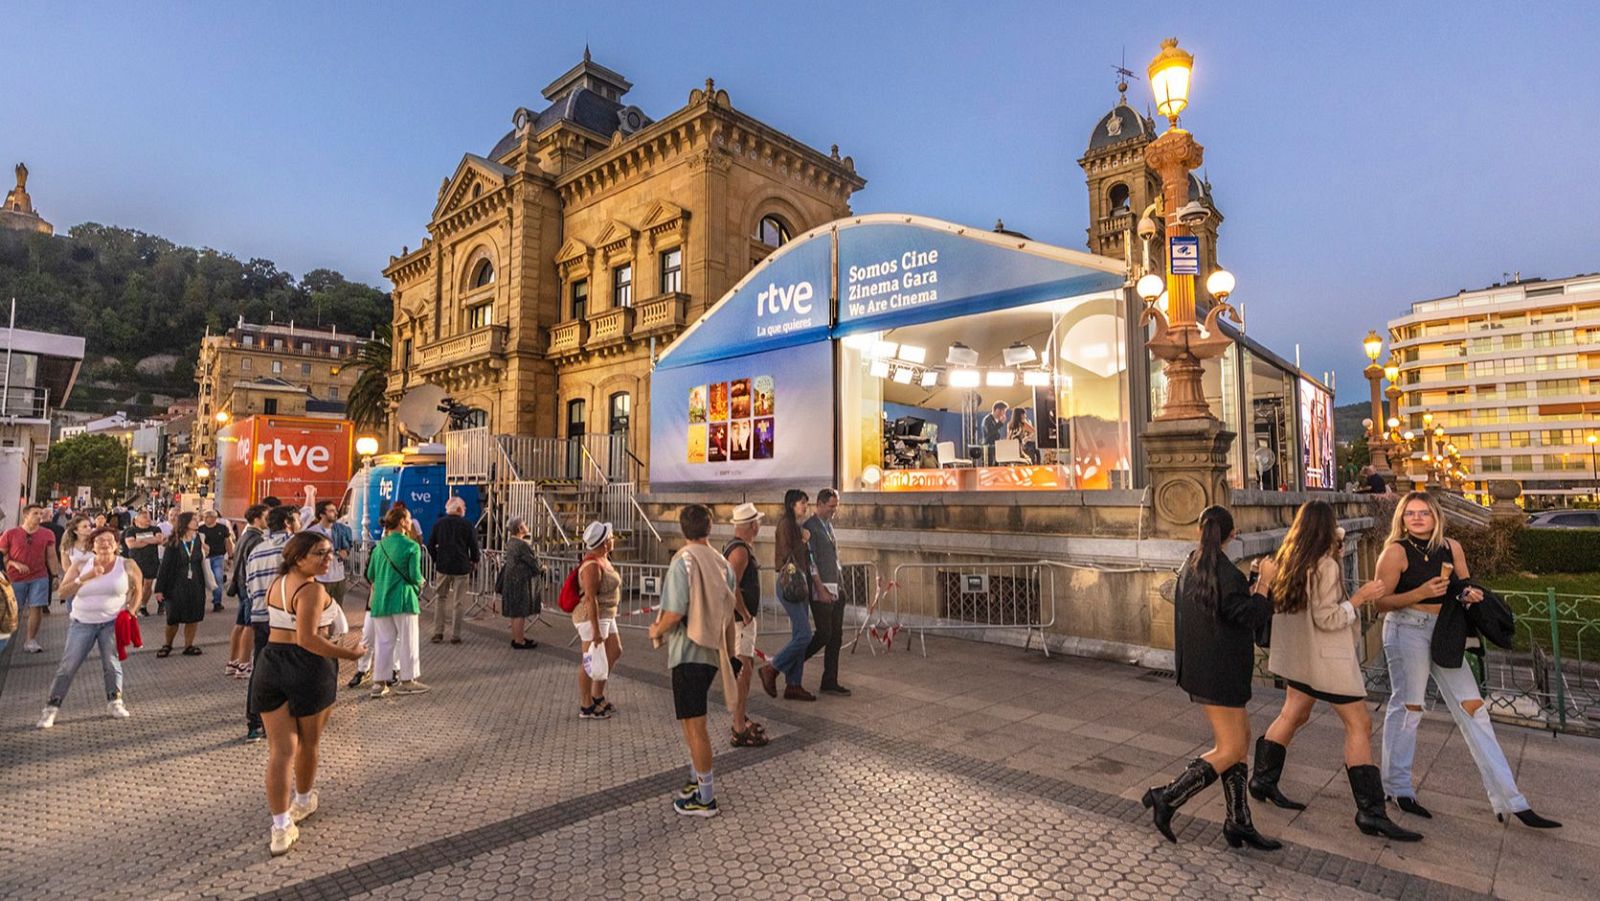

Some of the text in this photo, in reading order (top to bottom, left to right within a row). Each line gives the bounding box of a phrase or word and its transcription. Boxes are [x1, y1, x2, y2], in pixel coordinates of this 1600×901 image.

[849, 249, 938, 283] Somos Cine
[757, 281, 813, 317] rtve
[848, 270, 938, 301] Zinema Gara
[848, 289, 938, 316] We Are Cinema
[757, 317, 812, 337] La que quieres
[257, 438, 330, 473] rtve
[410, 491, 431, 503] tve
